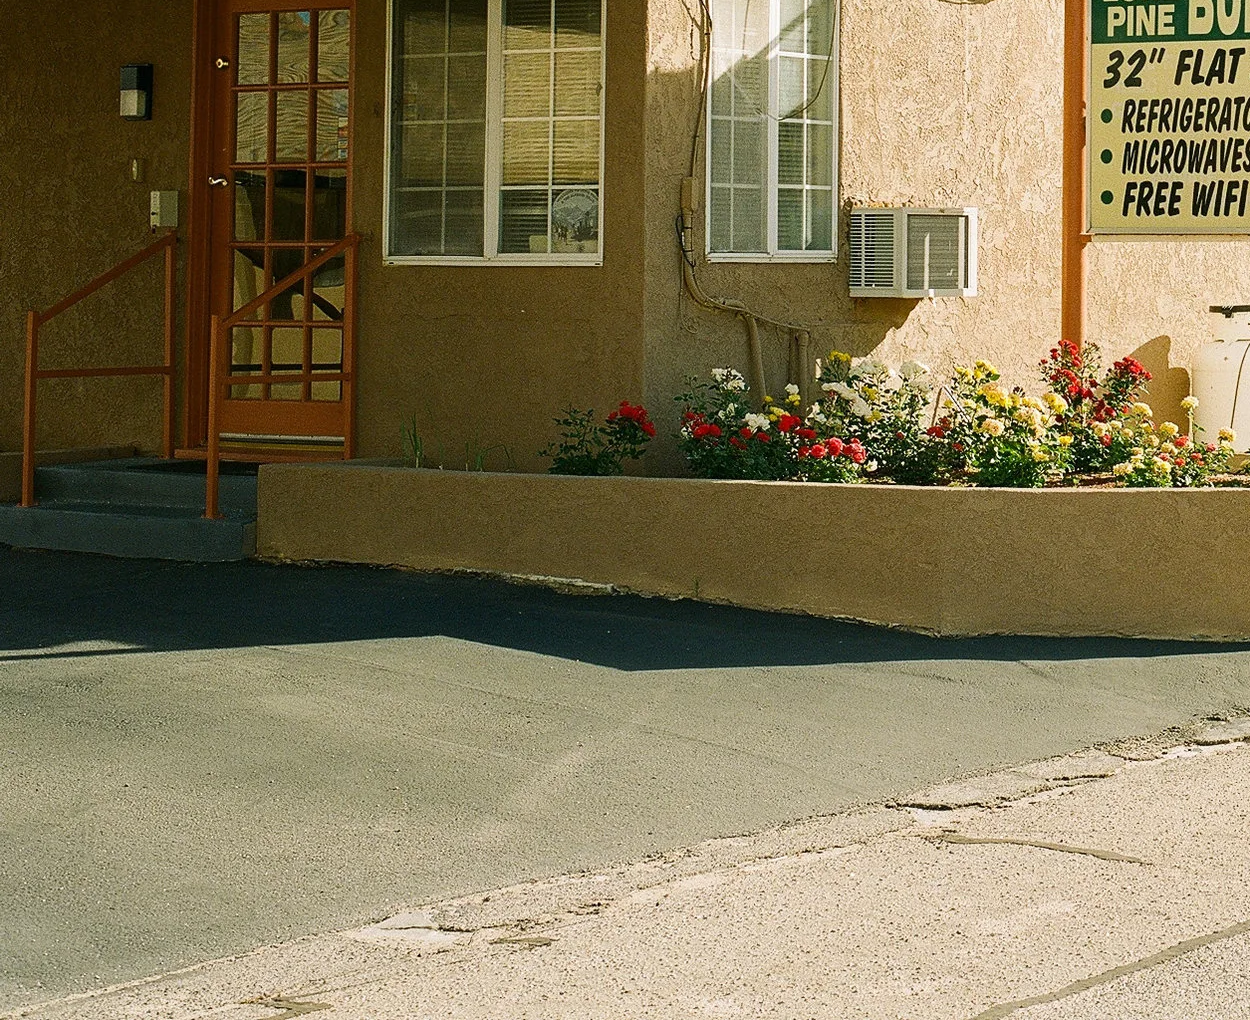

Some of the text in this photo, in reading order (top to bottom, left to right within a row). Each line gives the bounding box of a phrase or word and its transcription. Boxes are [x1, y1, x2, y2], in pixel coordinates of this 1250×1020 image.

[1107, 4, 1175, 37] PINE
[1103, 47, 1166, 89] 32"
[1174, 47, 1246, 87] FLAT
[1121, 180, 1184, 218] FREE
[1191, 179, 1250, 218] WIFI
